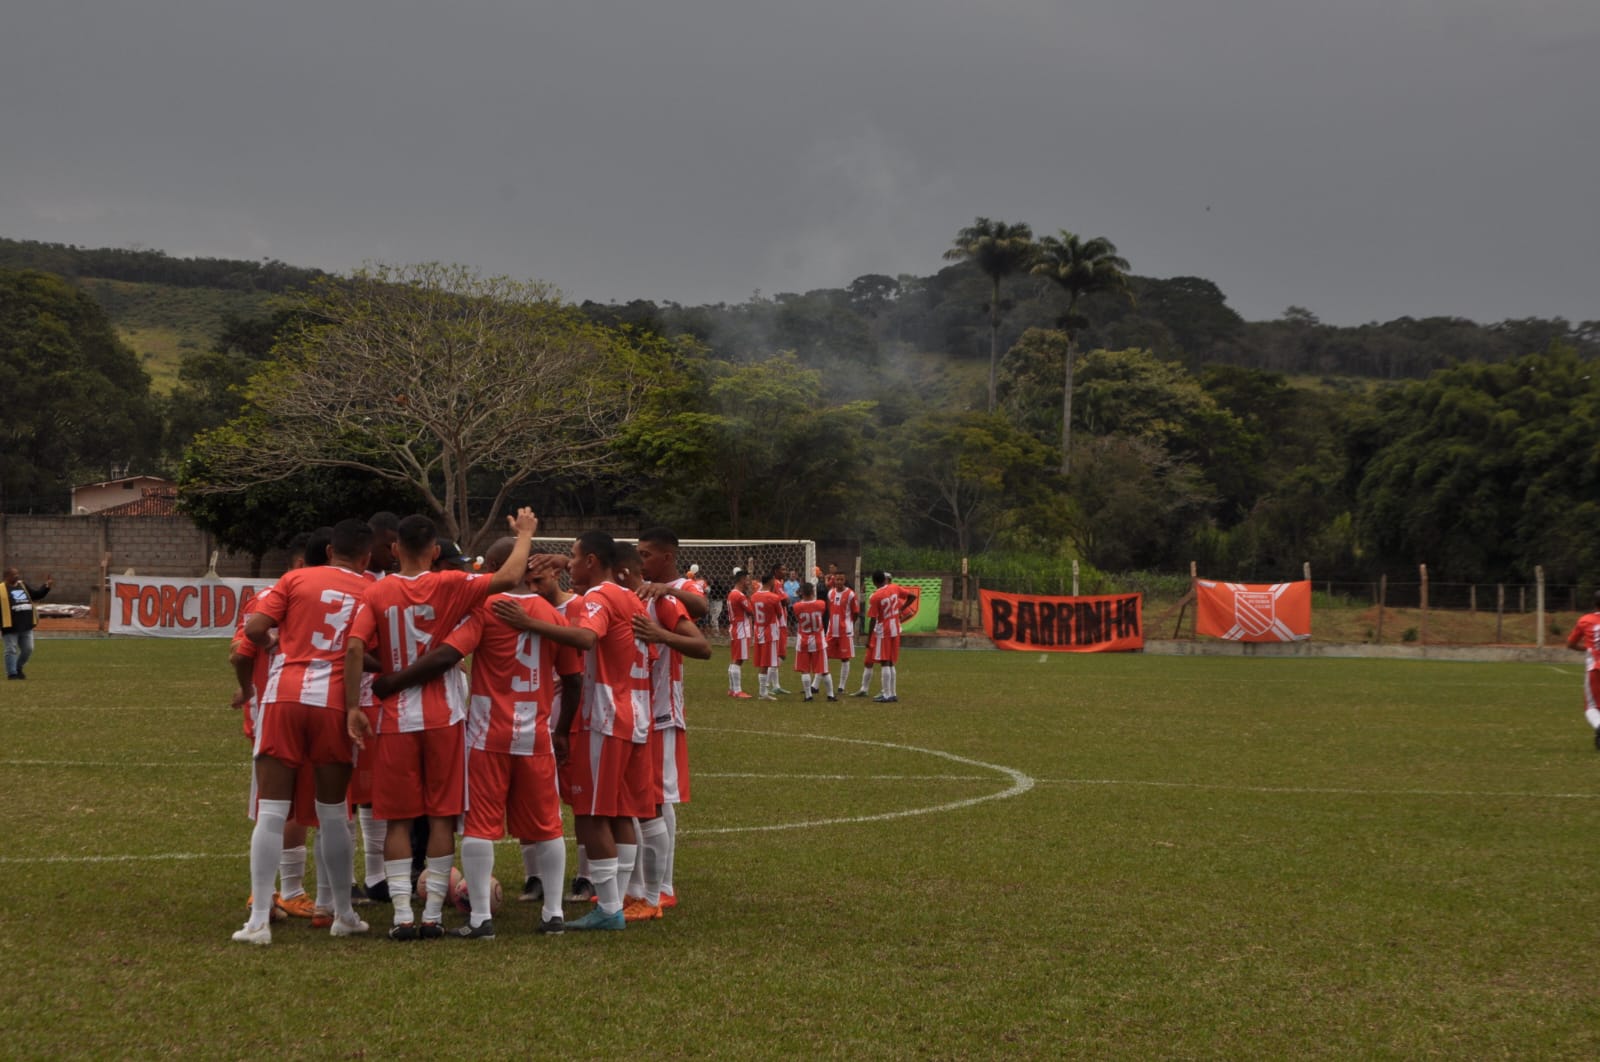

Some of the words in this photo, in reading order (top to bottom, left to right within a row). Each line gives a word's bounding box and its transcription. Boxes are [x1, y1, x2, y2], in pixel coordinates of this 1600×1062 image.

[311, 589, 355, 651] 3
[754, 602, 765, 623] 6
[799, 612, 822, 633] 20
[881, 594, 899, 618] 22
[991, 597, 1139, 646] BARRINHA
[384, 604, 435, 671] 16
[511, 630, 540, 692] 9
